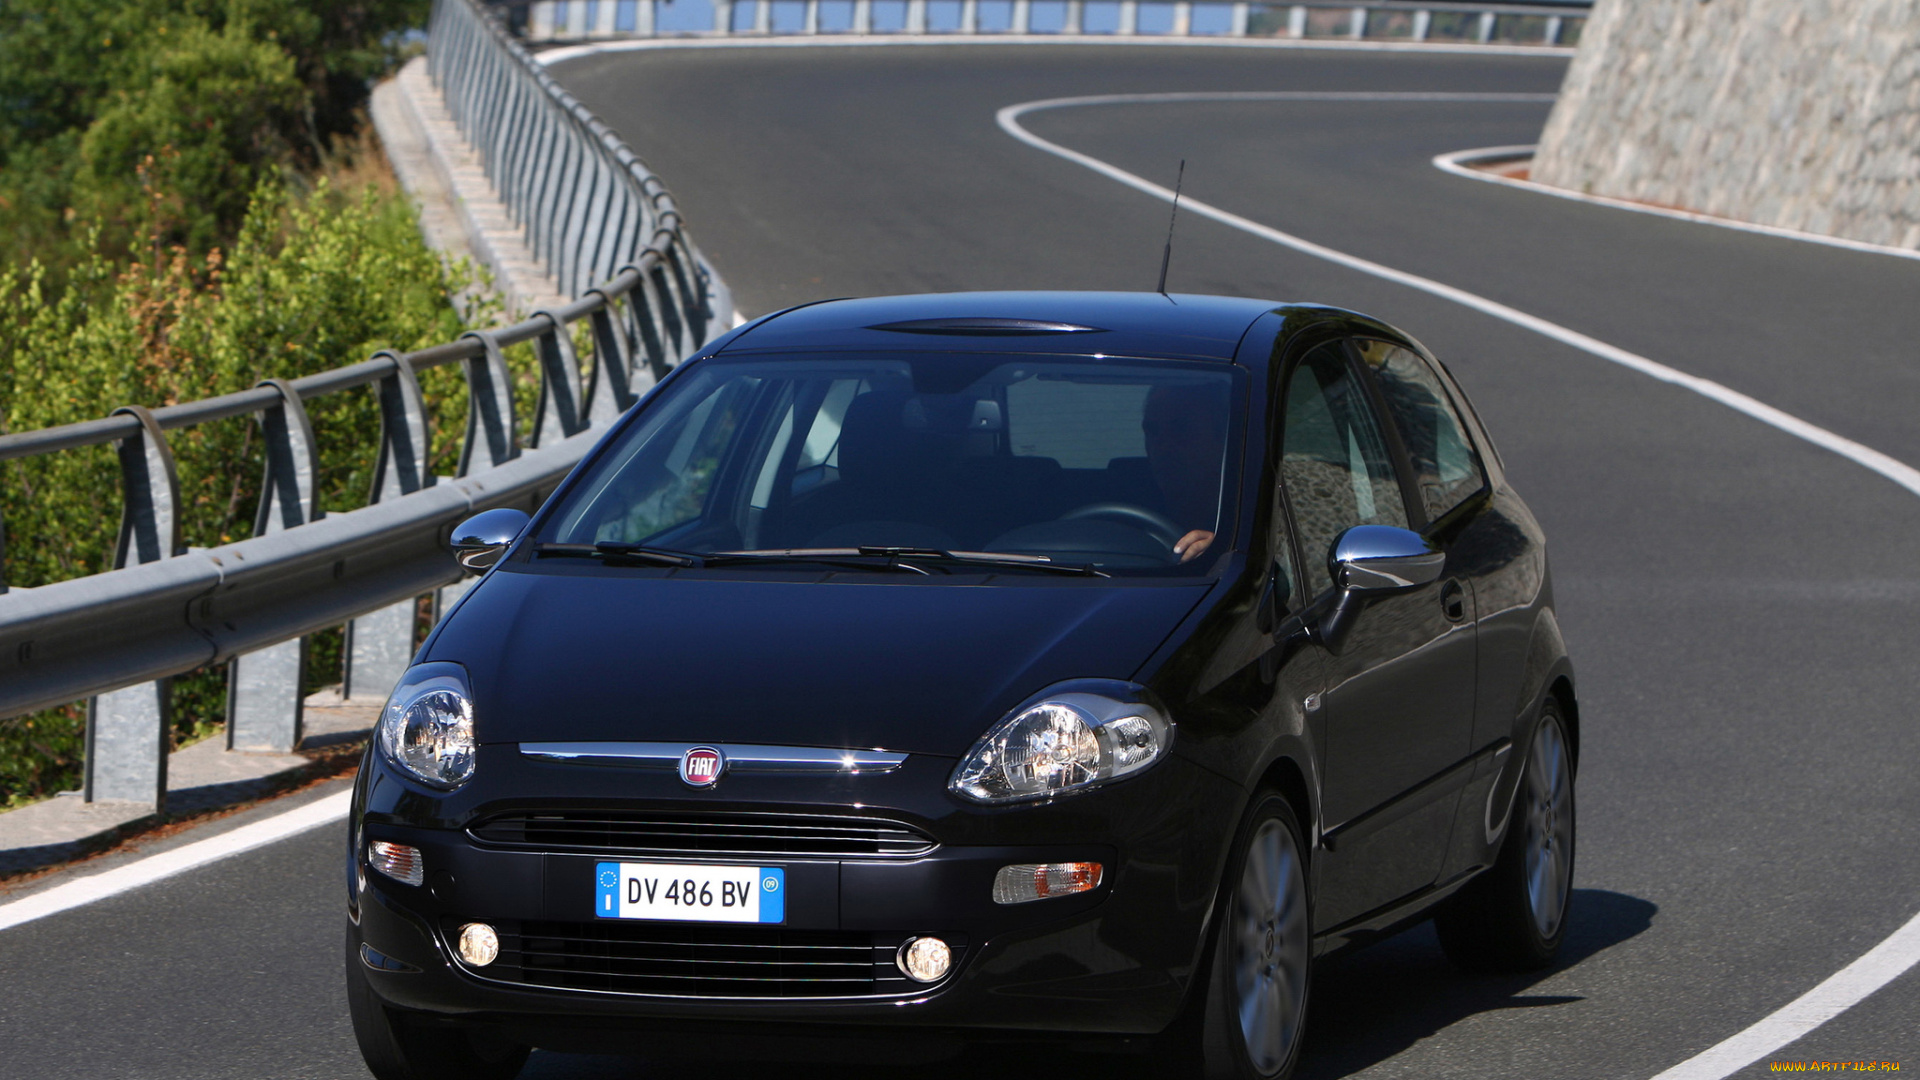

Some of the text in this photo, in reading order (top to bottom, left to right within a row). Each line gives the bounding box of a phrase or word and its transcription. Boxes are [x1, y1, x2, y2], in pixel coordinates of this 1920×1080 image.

[688, 757, 716, 775] FIAT
[628, 877, 751, 907] DV 486 BV
